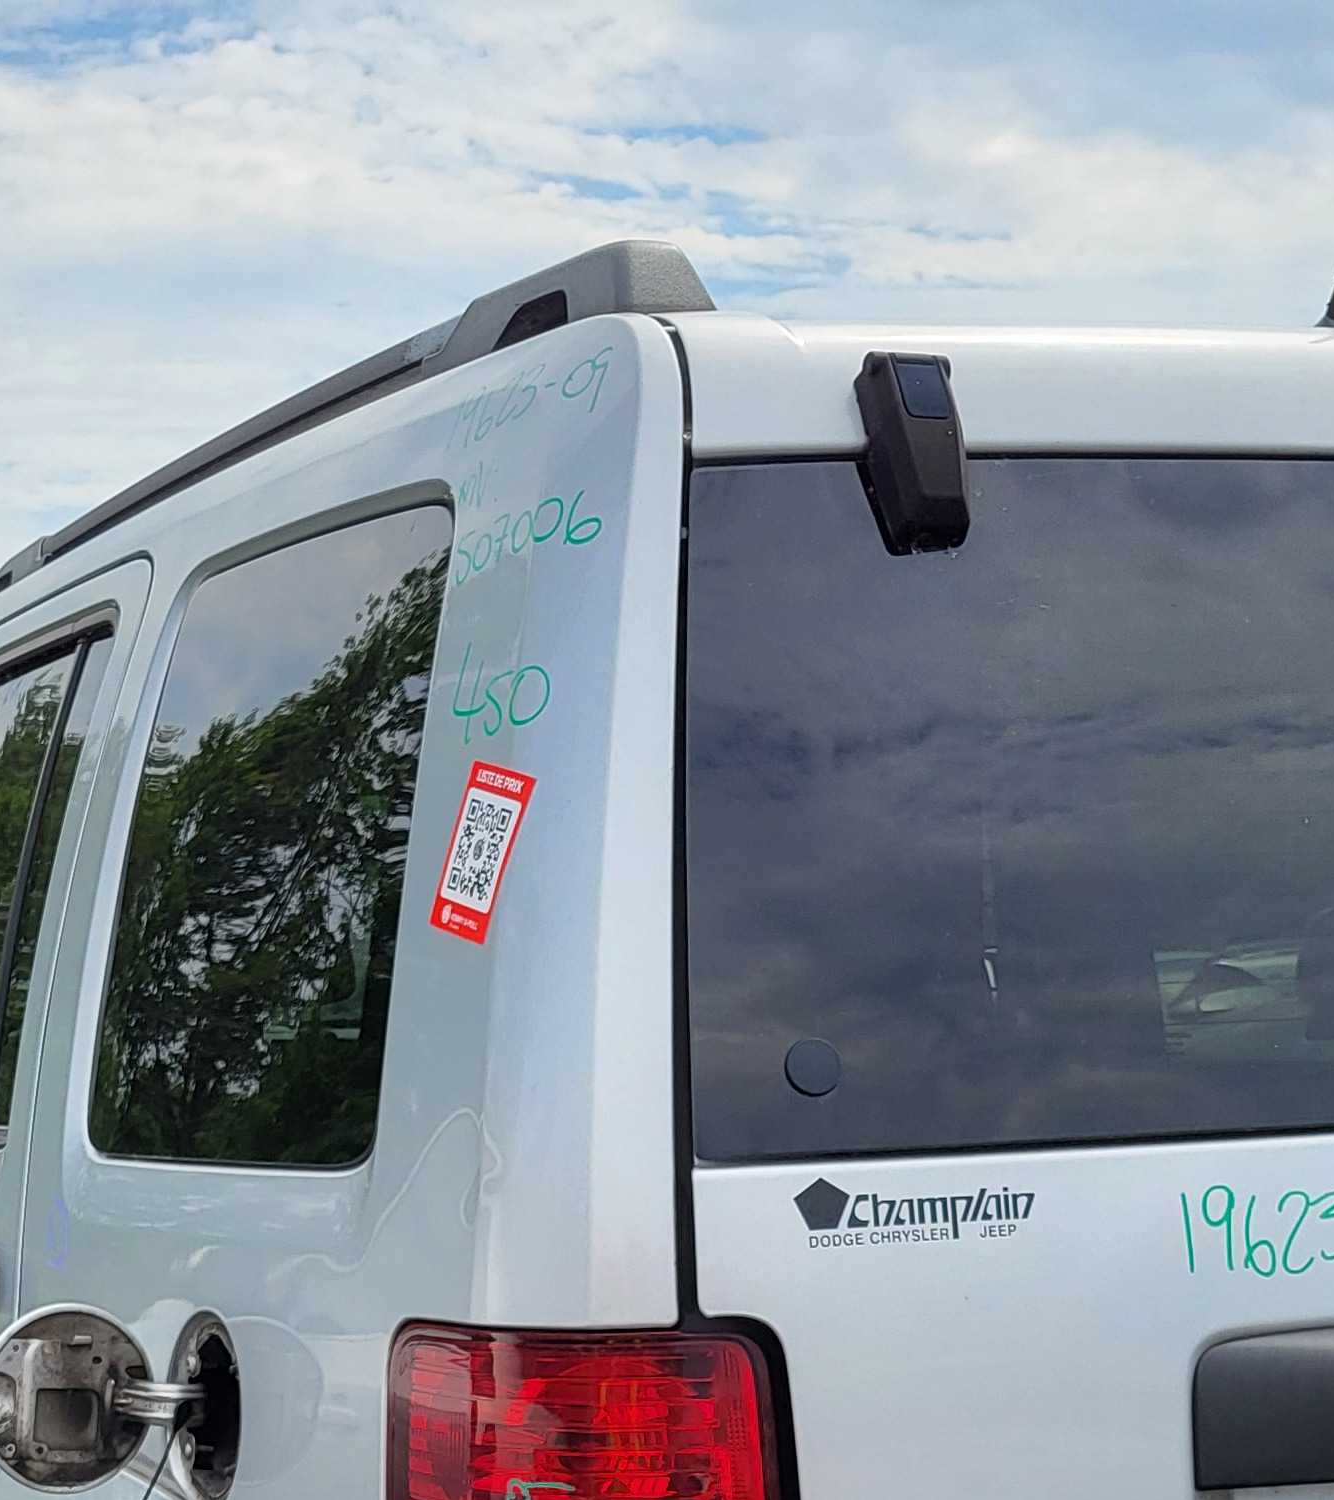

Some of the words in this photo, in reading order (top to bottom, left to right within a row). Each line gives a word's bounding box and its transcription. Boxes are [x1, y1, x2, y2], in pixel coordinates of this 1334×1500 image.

[455, 489, 603, 585] 507006
[452, 641, 550, 744] 450
[809, 1232, 864, 1249] DODGE
[870, 1227, 949, 1245] CHRYSLER
[979, 1224, 1017, 1239] JEEP
[847, 1187, 1035, 1239] Champlain
